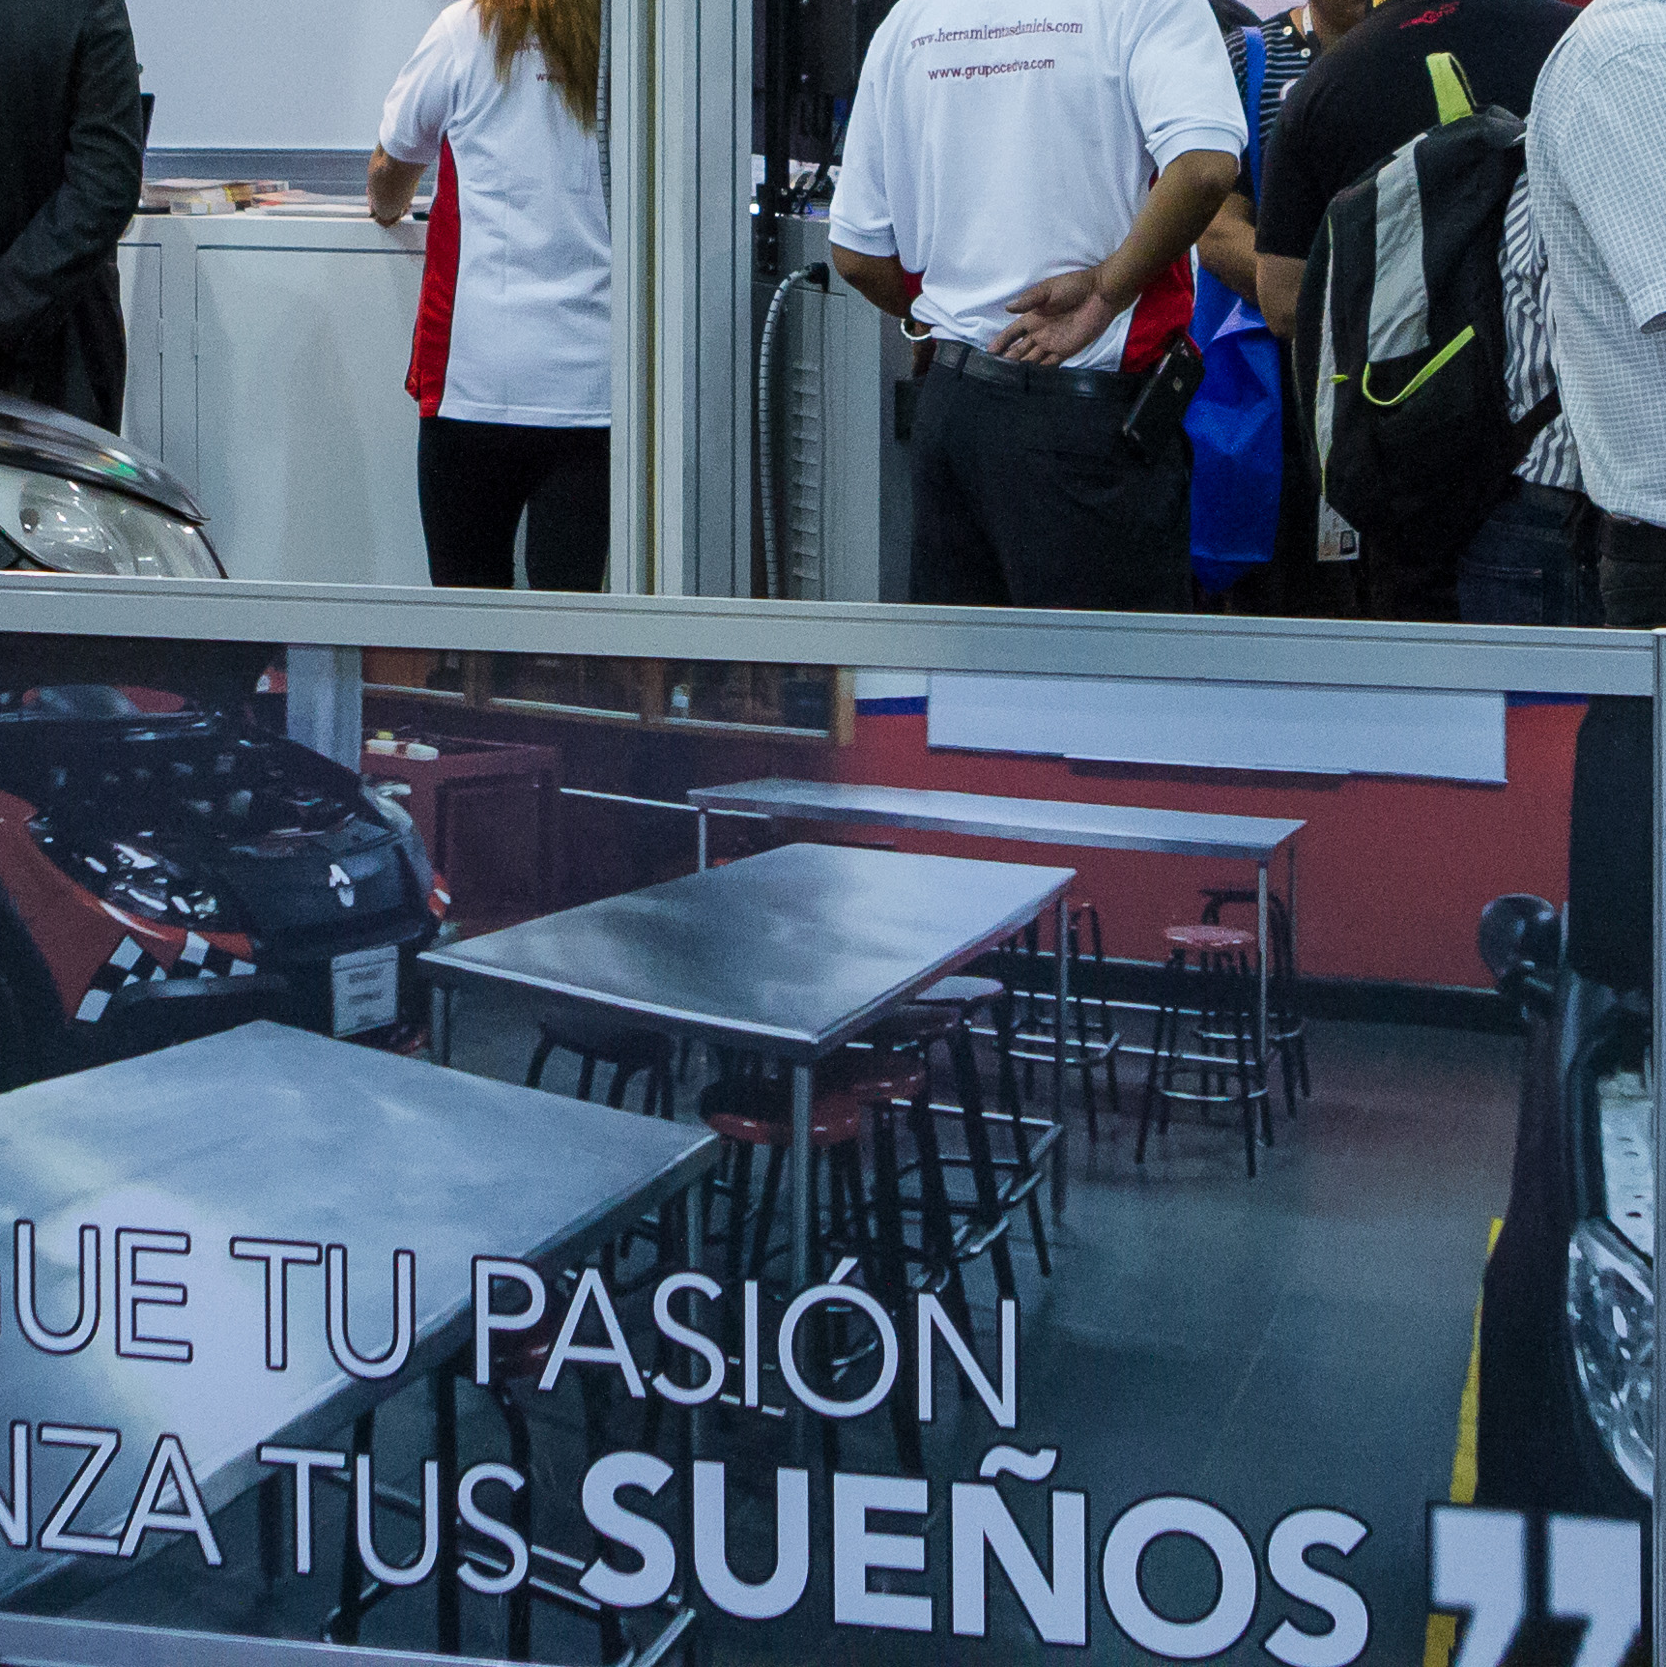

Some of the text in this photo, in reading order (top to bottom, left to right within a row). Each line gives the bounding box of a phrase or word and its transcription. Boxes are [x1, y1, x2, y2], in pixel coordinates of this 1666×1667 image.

[928, 59, 1055, 80] www.grupocedva.com
[229, 1236, 416, 1382] TU
[470, 1254, 1020, 1431] PASIÓN
[256, 1442, 531, 1598] TUS
[577, 1444, 1371, 1667] SUEÑOS
